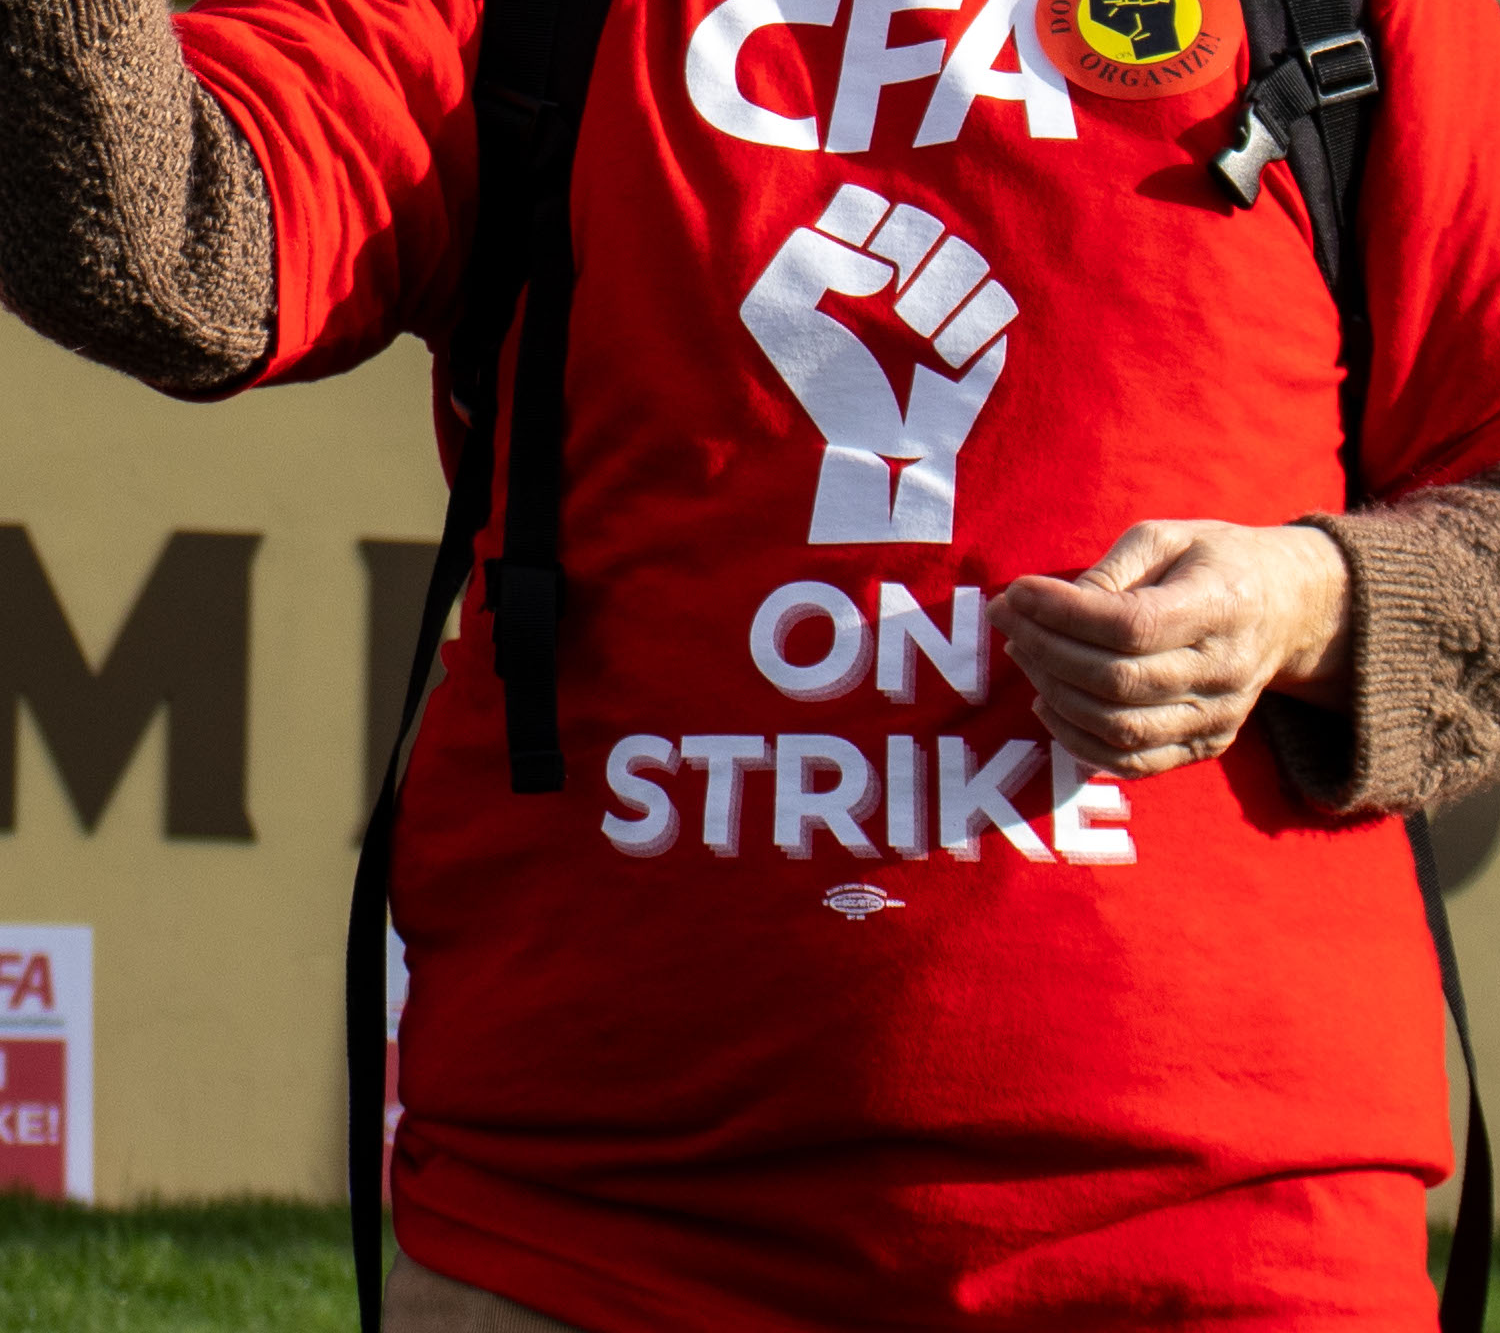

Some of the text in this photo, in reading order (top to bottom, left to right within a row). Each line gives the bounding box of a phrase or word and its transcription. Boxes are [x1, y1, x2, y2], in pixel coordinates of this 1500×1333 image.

[1079, 31, 1223, 87] ORGANIZE!
[748, 581, 992, 706] ON
[601, 734, 1138, 865] STRIKE
